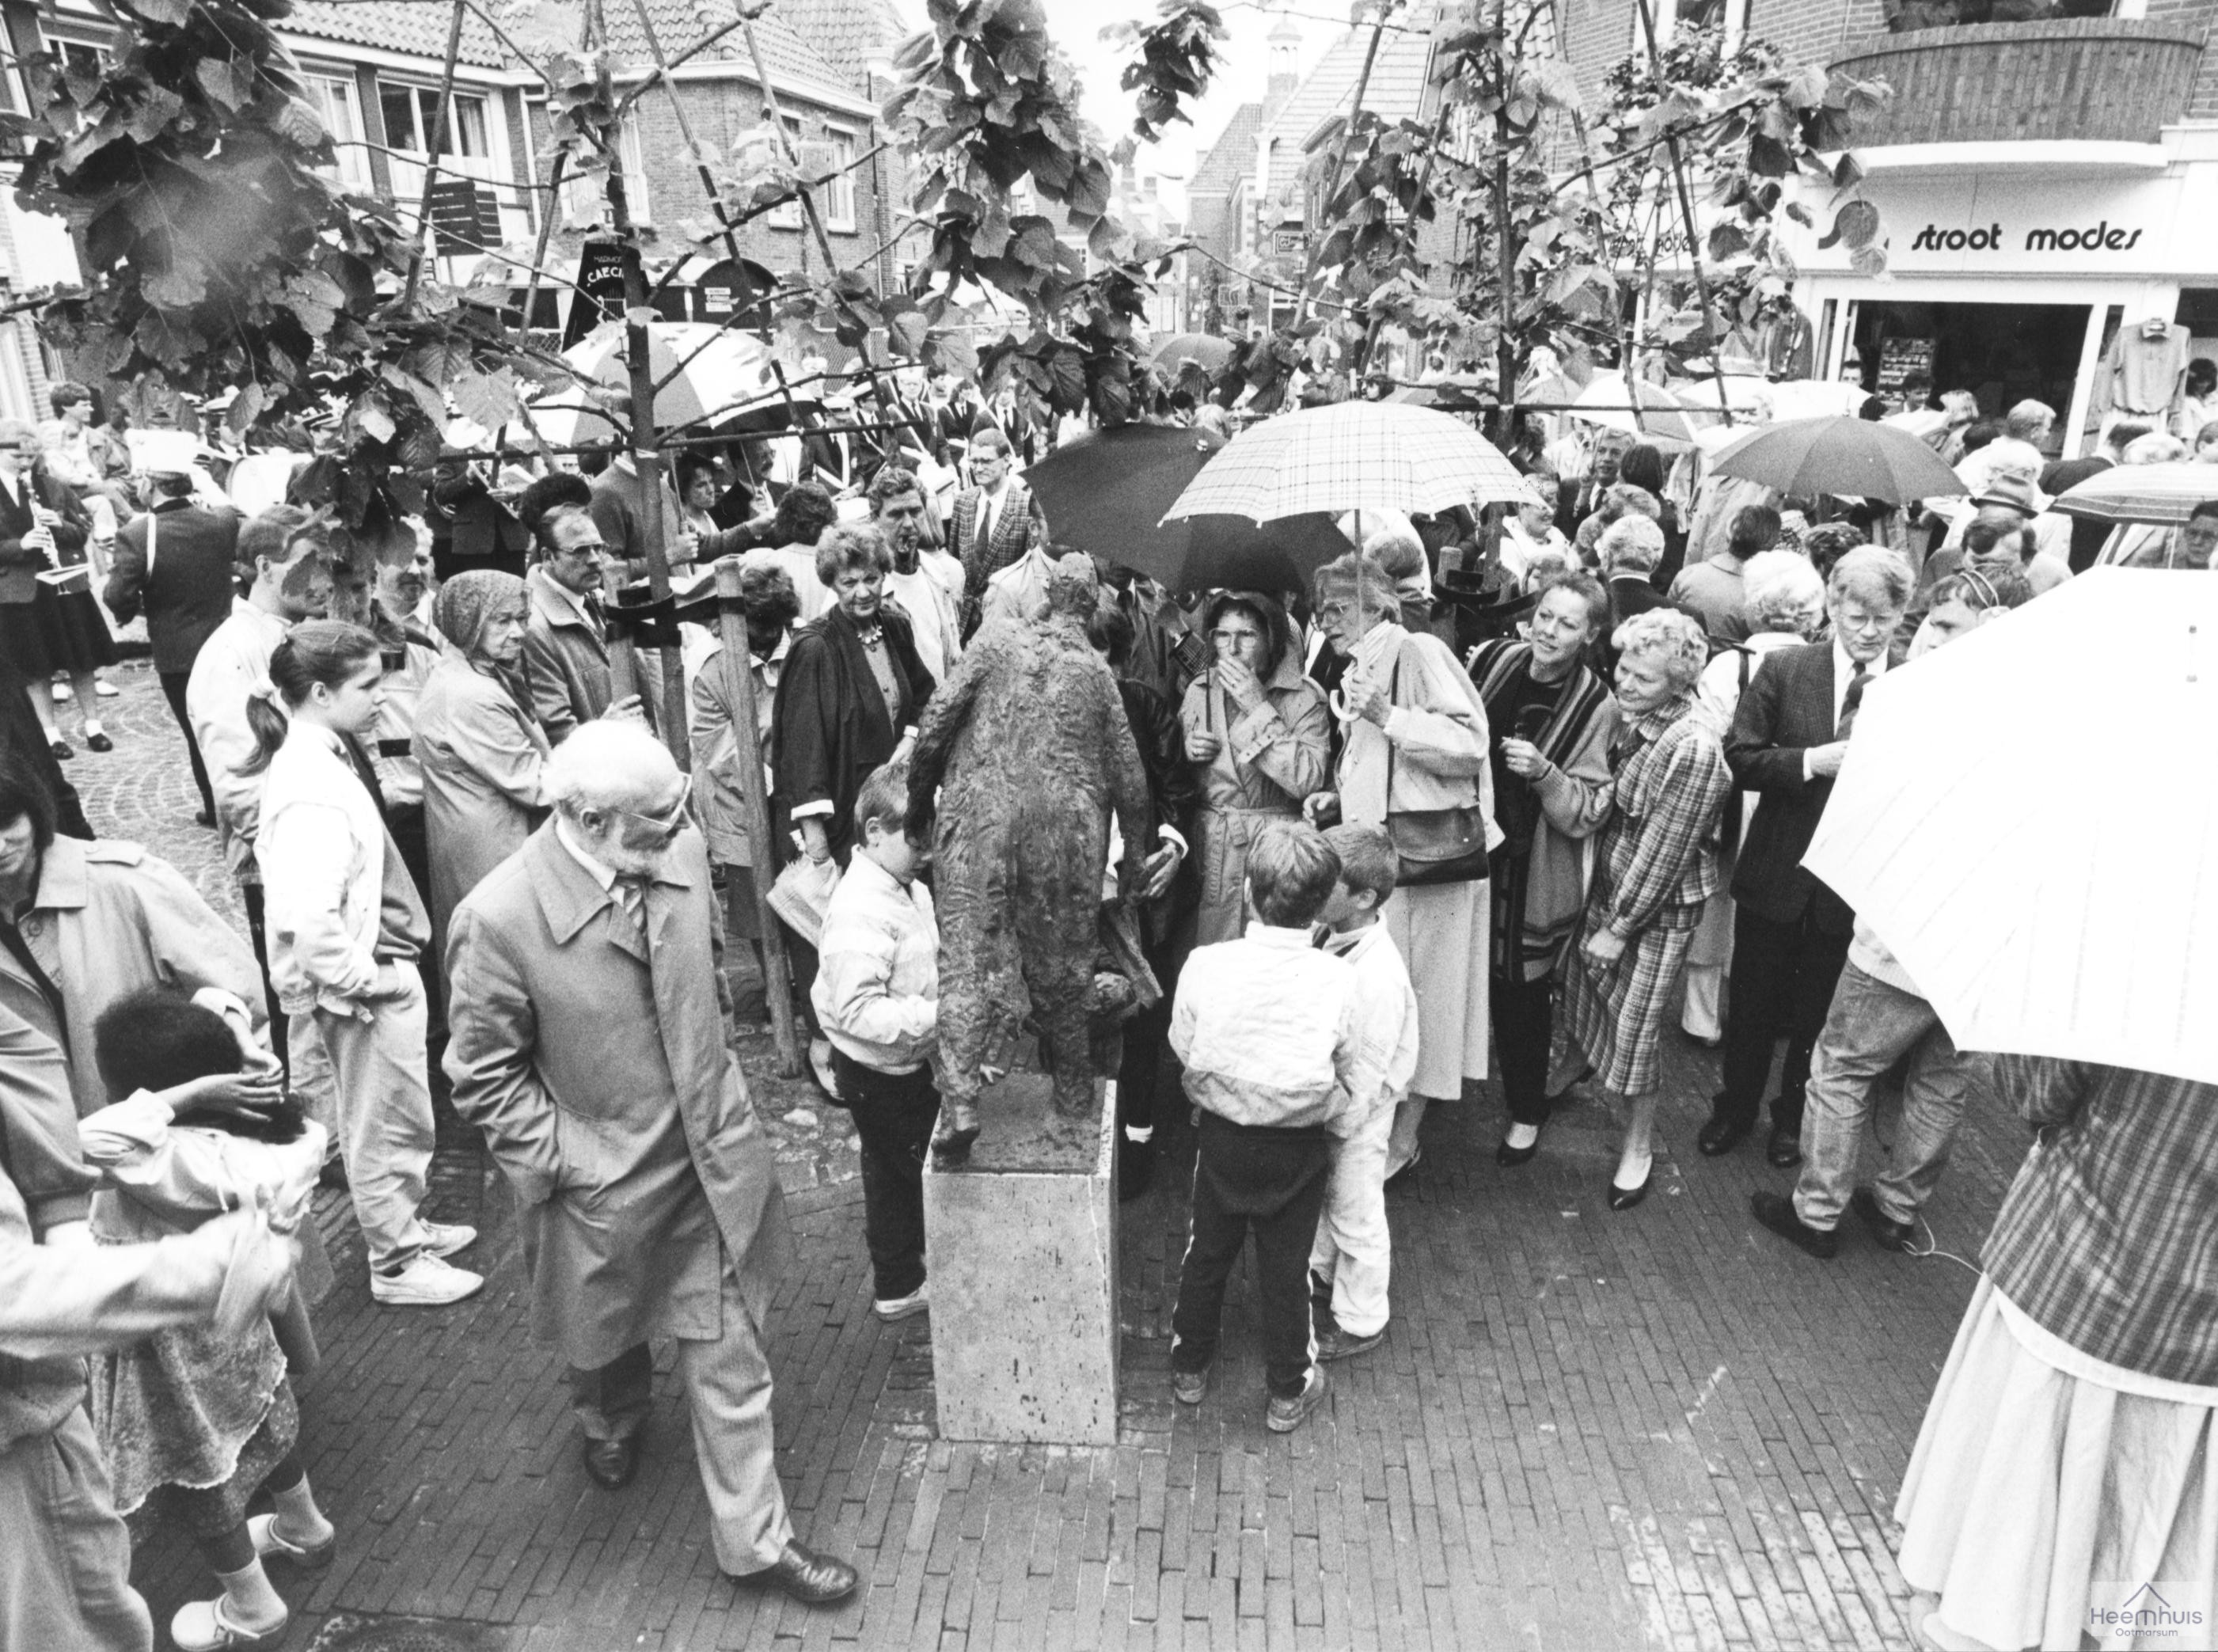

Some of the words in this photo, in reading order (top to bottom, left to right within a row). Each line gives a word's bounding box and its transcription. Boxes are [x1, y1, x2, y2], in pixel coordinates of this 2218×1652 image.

[1912, 223, 2002, 250] stroot
[2025, 221, 2142, 250] modes
[587, 266, 625, 283] CAECI
